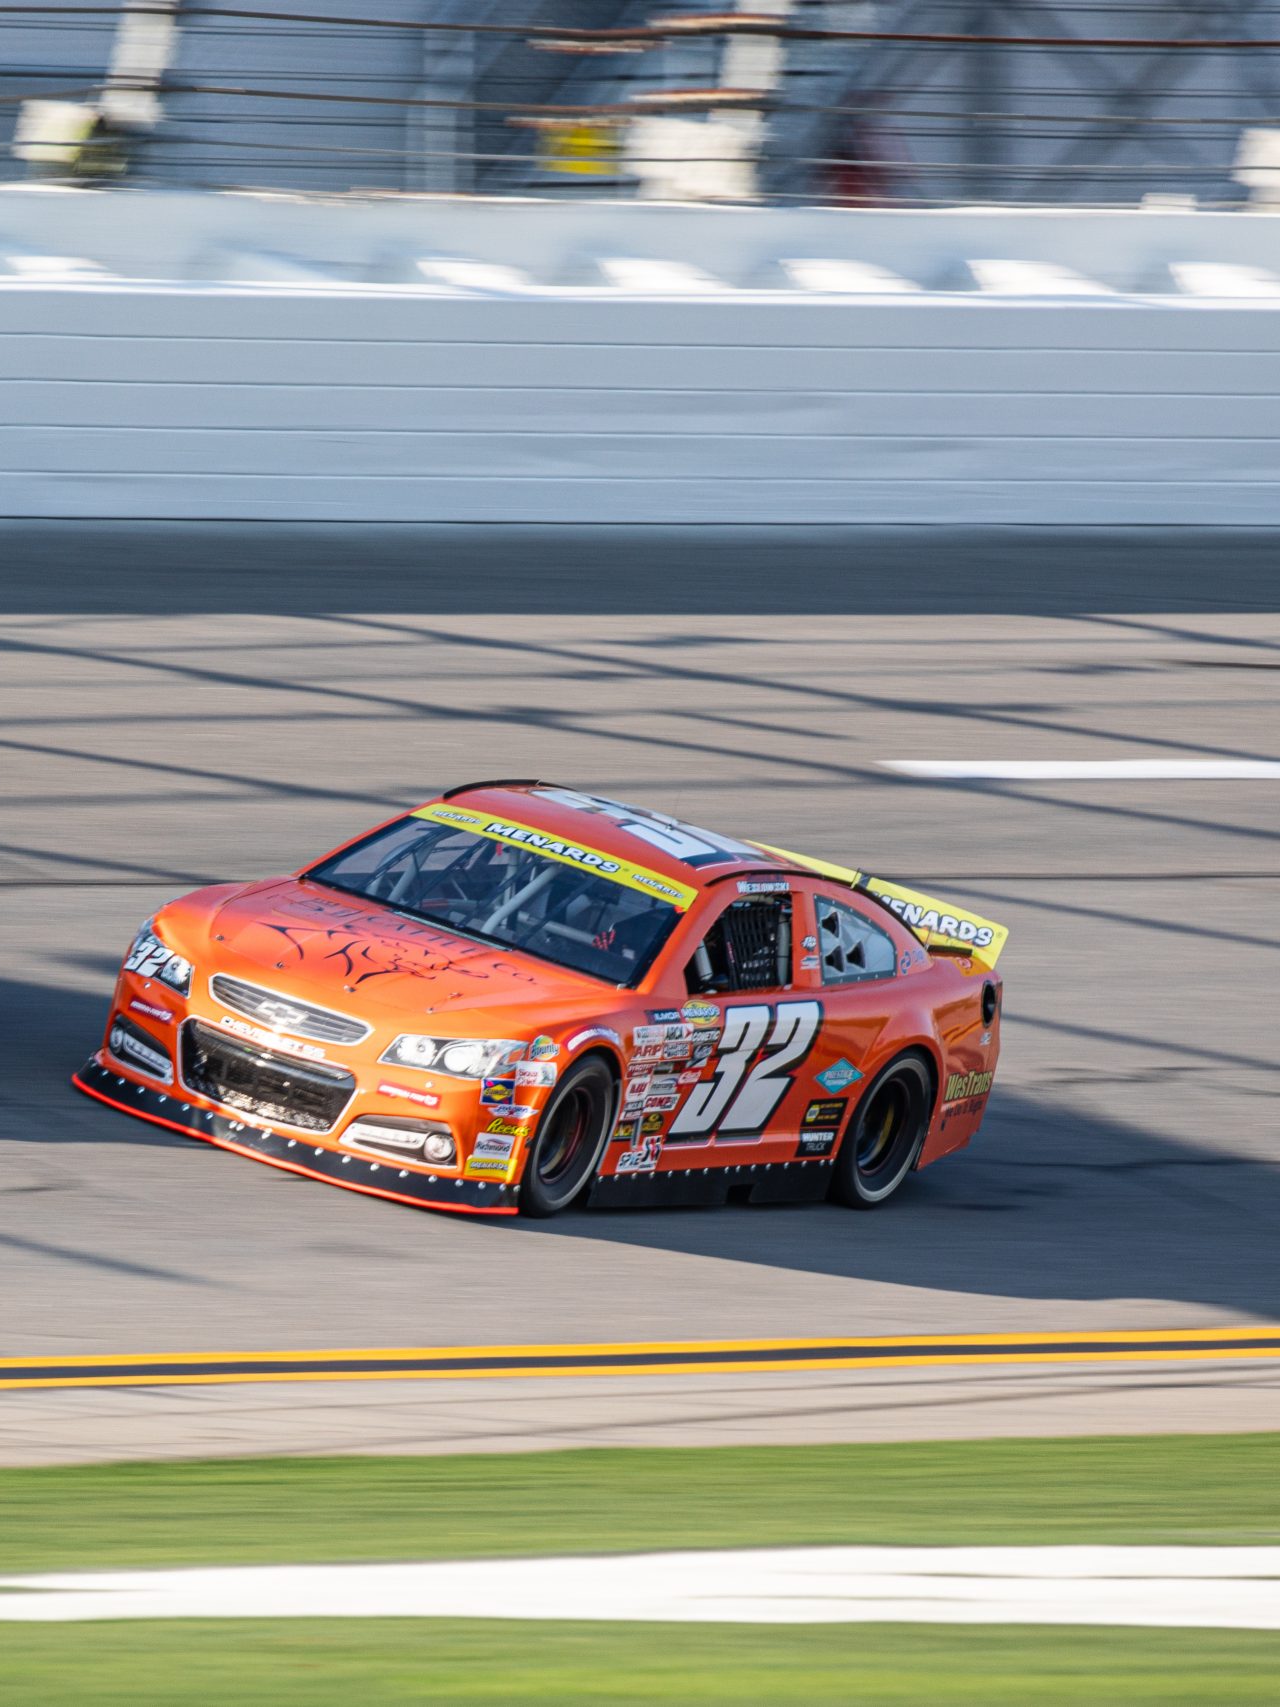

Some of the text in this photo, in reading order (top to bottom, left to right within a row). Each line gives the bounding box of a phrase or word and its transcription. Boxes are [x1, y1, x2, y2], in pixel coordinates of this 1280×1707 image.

[486, 822, 621, 873] MENARDS
[873, 891, 994, 947] ENARDS
[123, 940, 176, 978] 32
[531, 1043, 560, 1060] Bounty
[666, 1001, 822, 1136] 32
